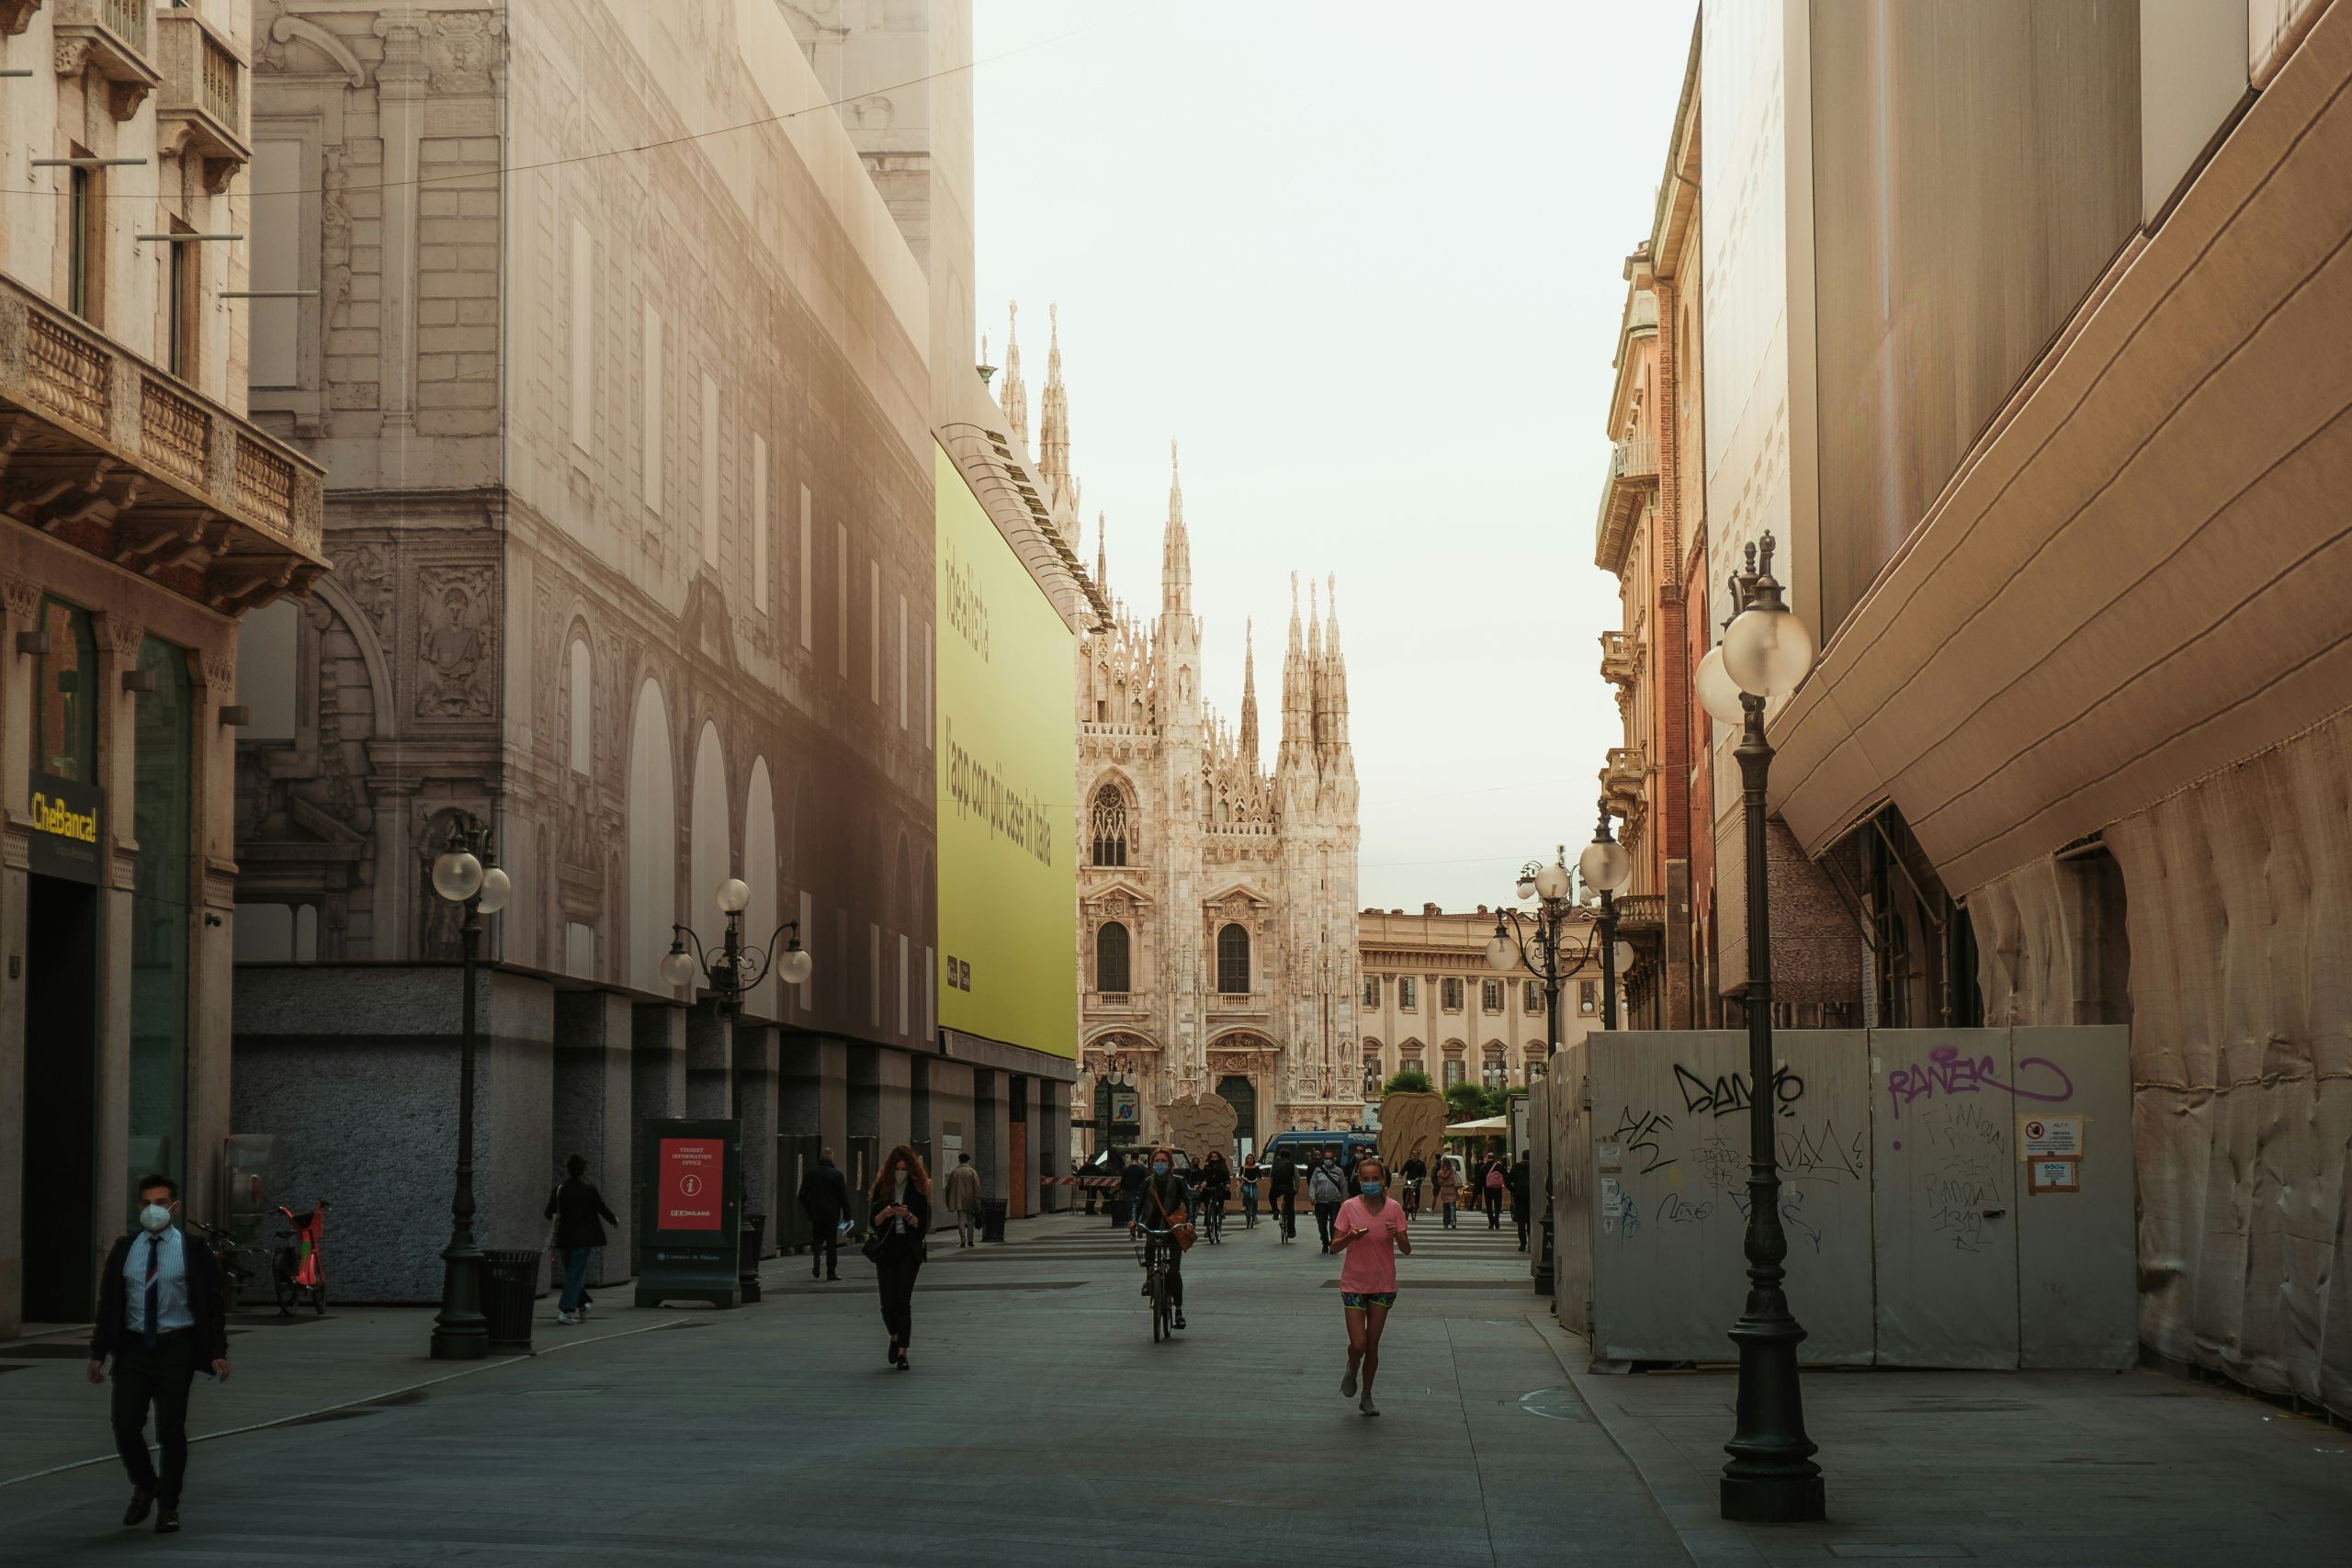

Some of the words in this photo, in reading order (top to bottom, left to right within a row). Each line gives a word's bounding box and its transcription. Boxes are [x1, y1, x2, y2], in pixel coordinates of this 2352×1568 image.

[945, 536, 989, 663] idealista
[31, 792, 96, 843] CheBanca!
[972, 759, 988, 821] con
[990, 761, 1004, 840] più
[1006, 787, 1024, 848] case
[1025, 787, 1033, 854] in
[1035, 794, 1051, 867] Italia
